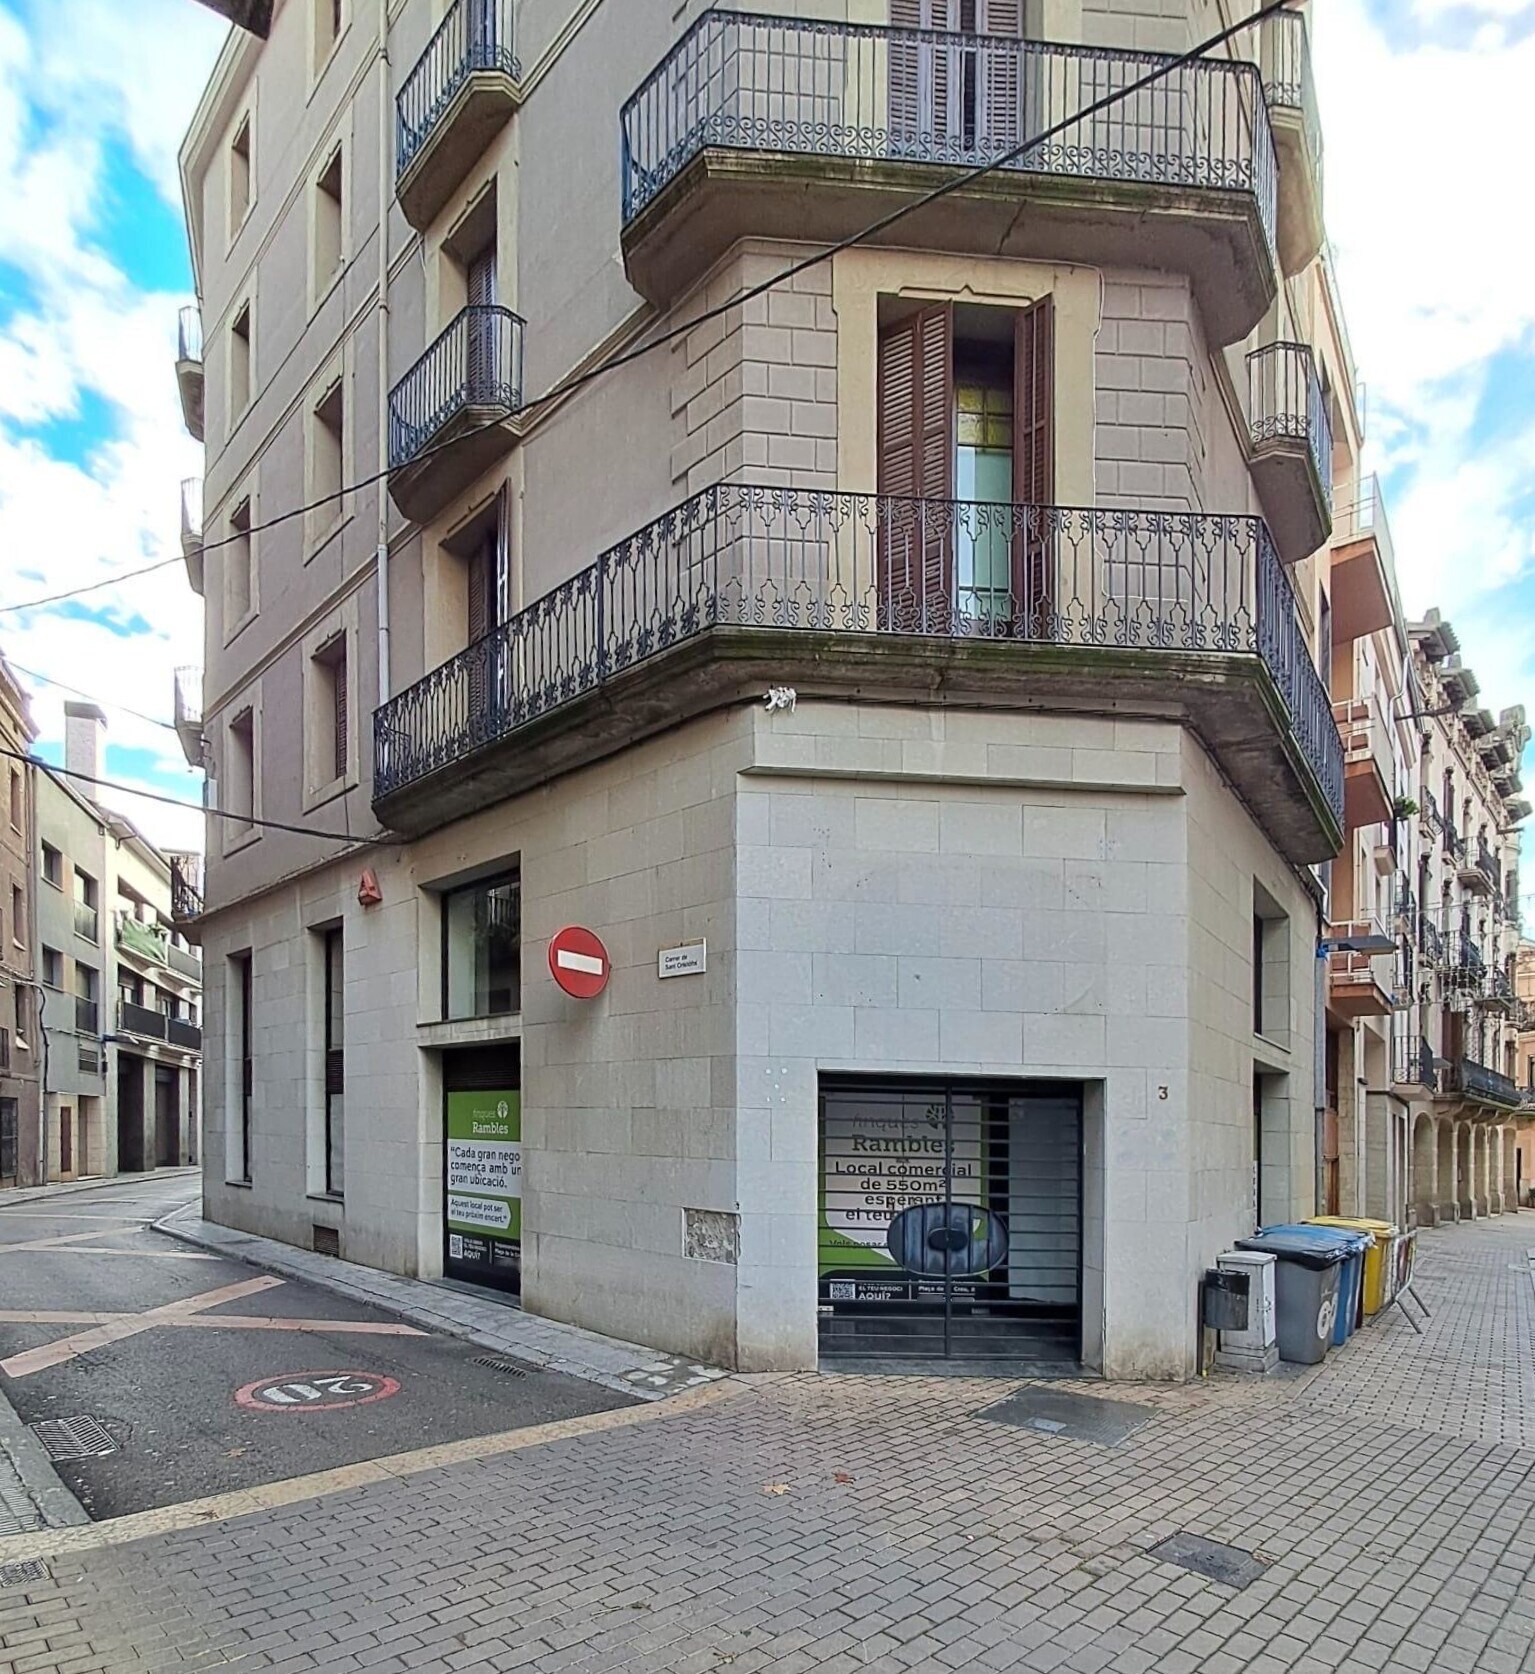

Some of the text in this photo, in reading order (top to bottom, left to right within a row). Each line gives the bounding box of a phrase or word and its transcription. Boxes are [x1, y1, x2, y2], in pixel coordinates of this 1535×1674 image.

[1158, 1085, 1169, 1100] 3
[472, 1121, 509, 1134] Rambles
[478, 1150, 496, 1161] gran
[451, 1161, 486, 1176] comença
[489, 1163, 508, 1175] amb
[835, 1161, 883, 1174] Local
[451, 1174, 468, 1185] gran
[860, 1178, 881, 1190] de
